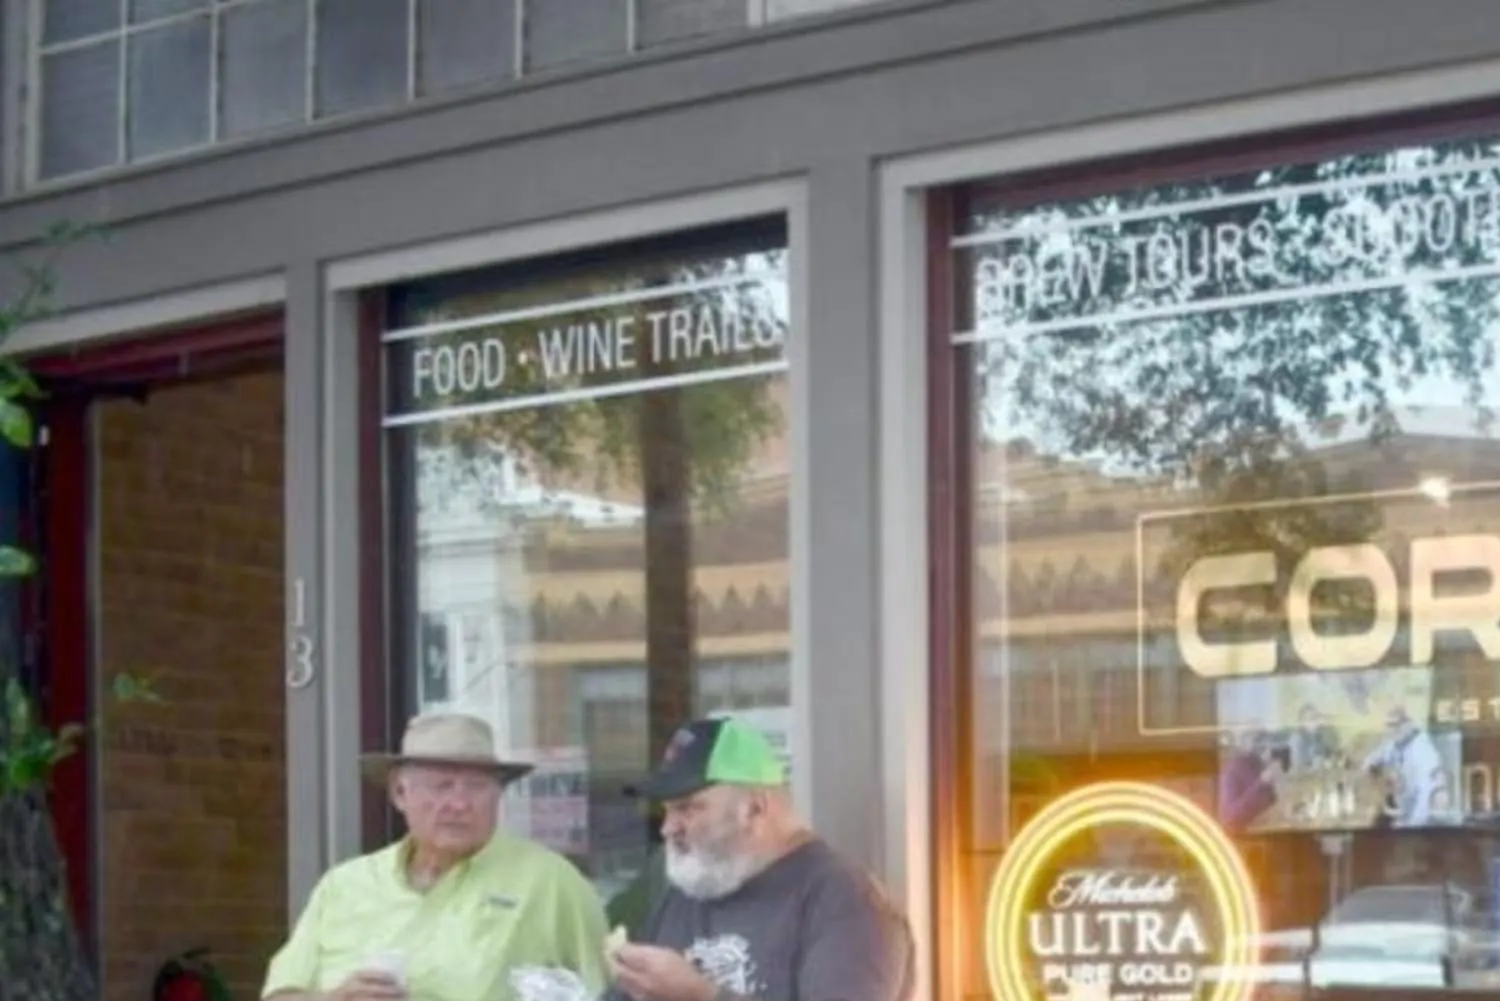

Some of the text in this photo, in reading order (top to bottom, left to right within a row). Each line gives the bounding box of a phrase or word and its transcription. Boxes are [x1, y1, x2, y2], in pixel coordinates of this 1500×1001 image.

[1121, 217, 1277, 297] TOURS
[412, 337, 507, 398] FOOD
[538, 315, 636, 380] WINE
[1029, 908, 1209, 957] ULTRA
[1118, 961, 1194, 985] GOLD
